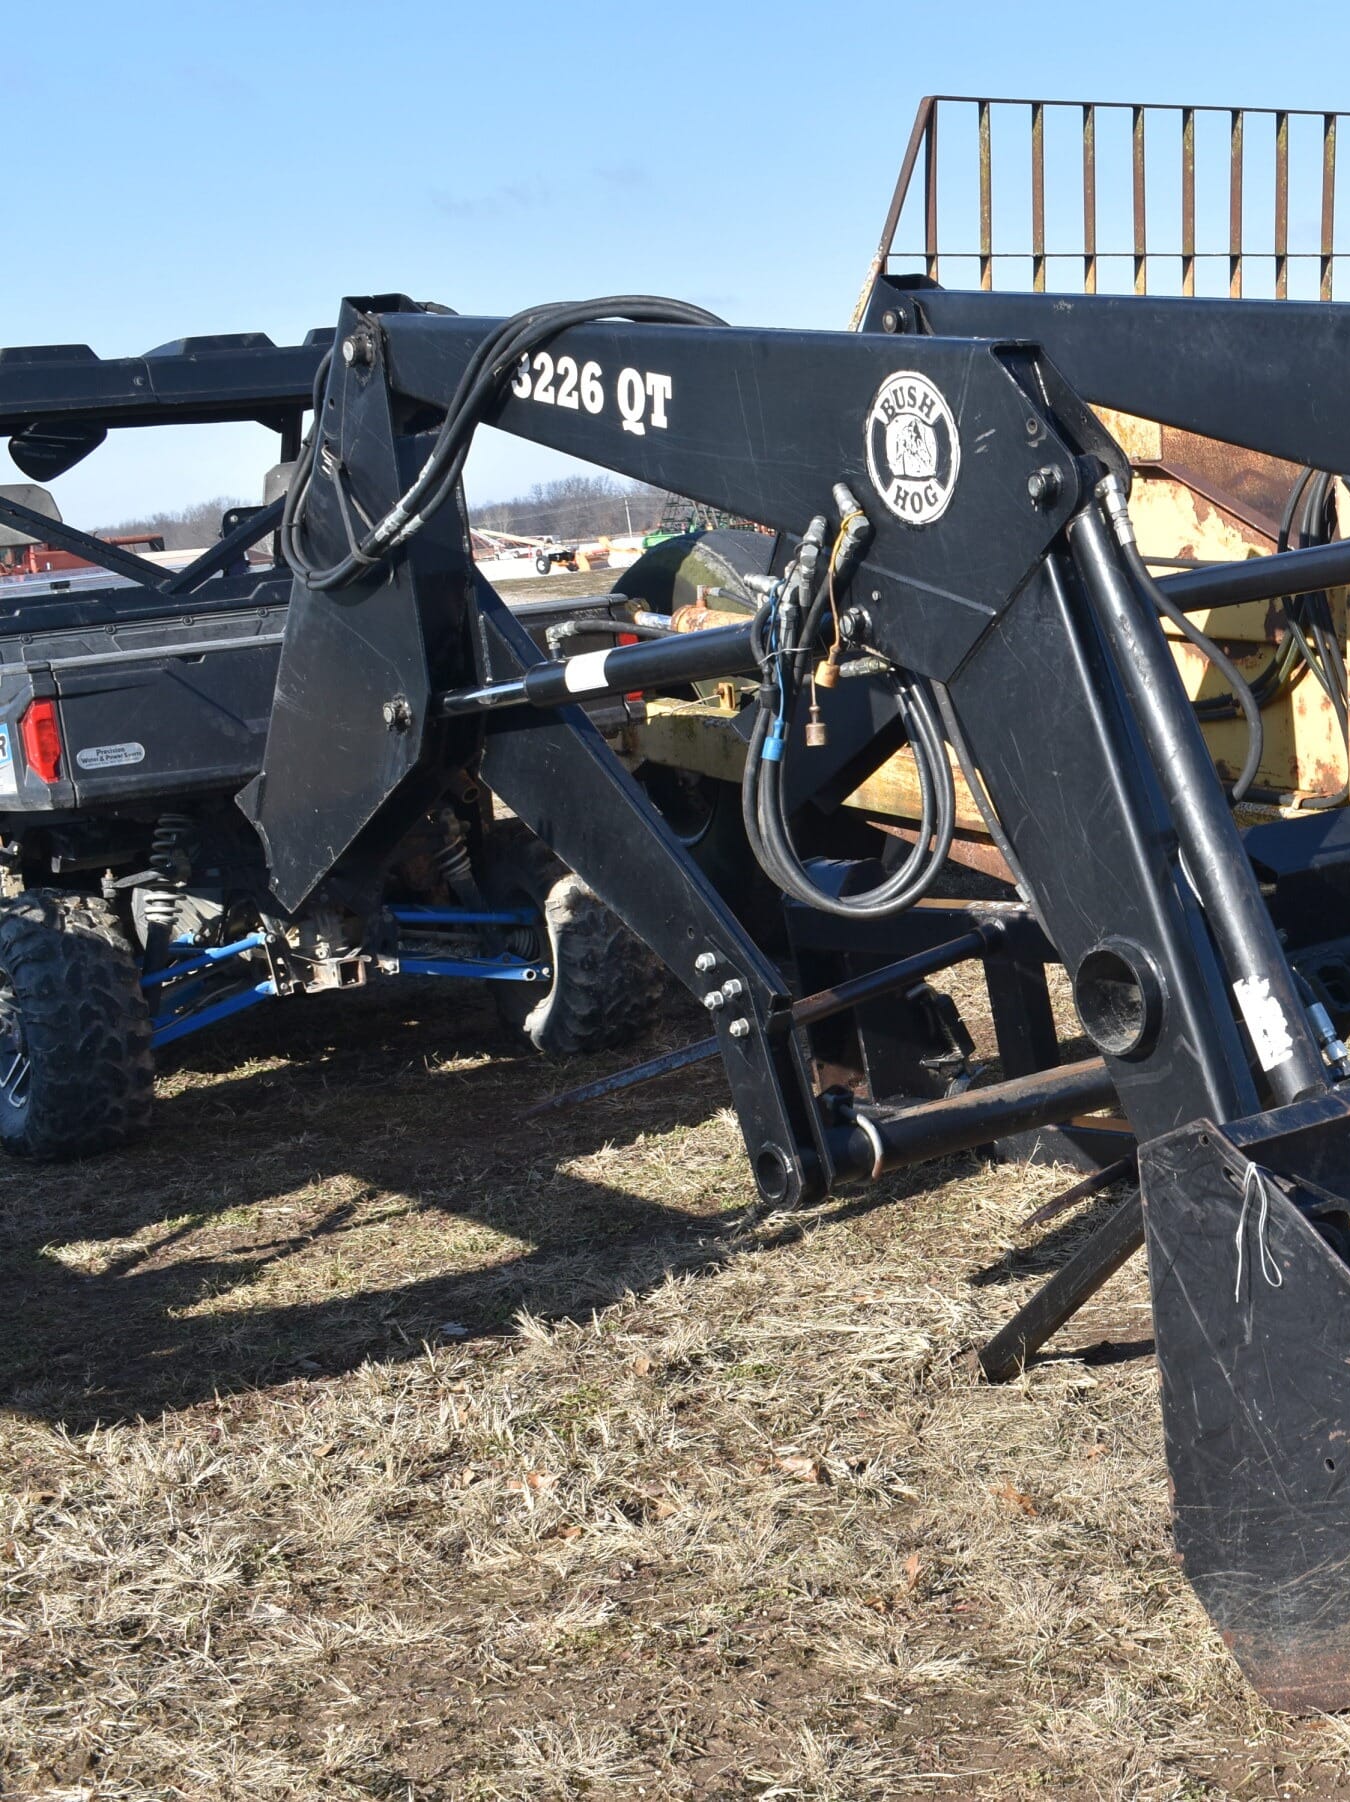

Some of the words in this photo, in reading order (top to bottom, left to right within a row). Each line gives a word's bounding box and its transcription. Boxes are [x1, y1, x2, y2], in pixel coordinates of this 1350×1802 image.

[511, 352, 604, 414] 3226
[617, 367, 672, 435] QT
[880, 385, 936, 423] BUSH
[893, 485, 939, 513] HOG
[95, 747, 125, 756] Precision
